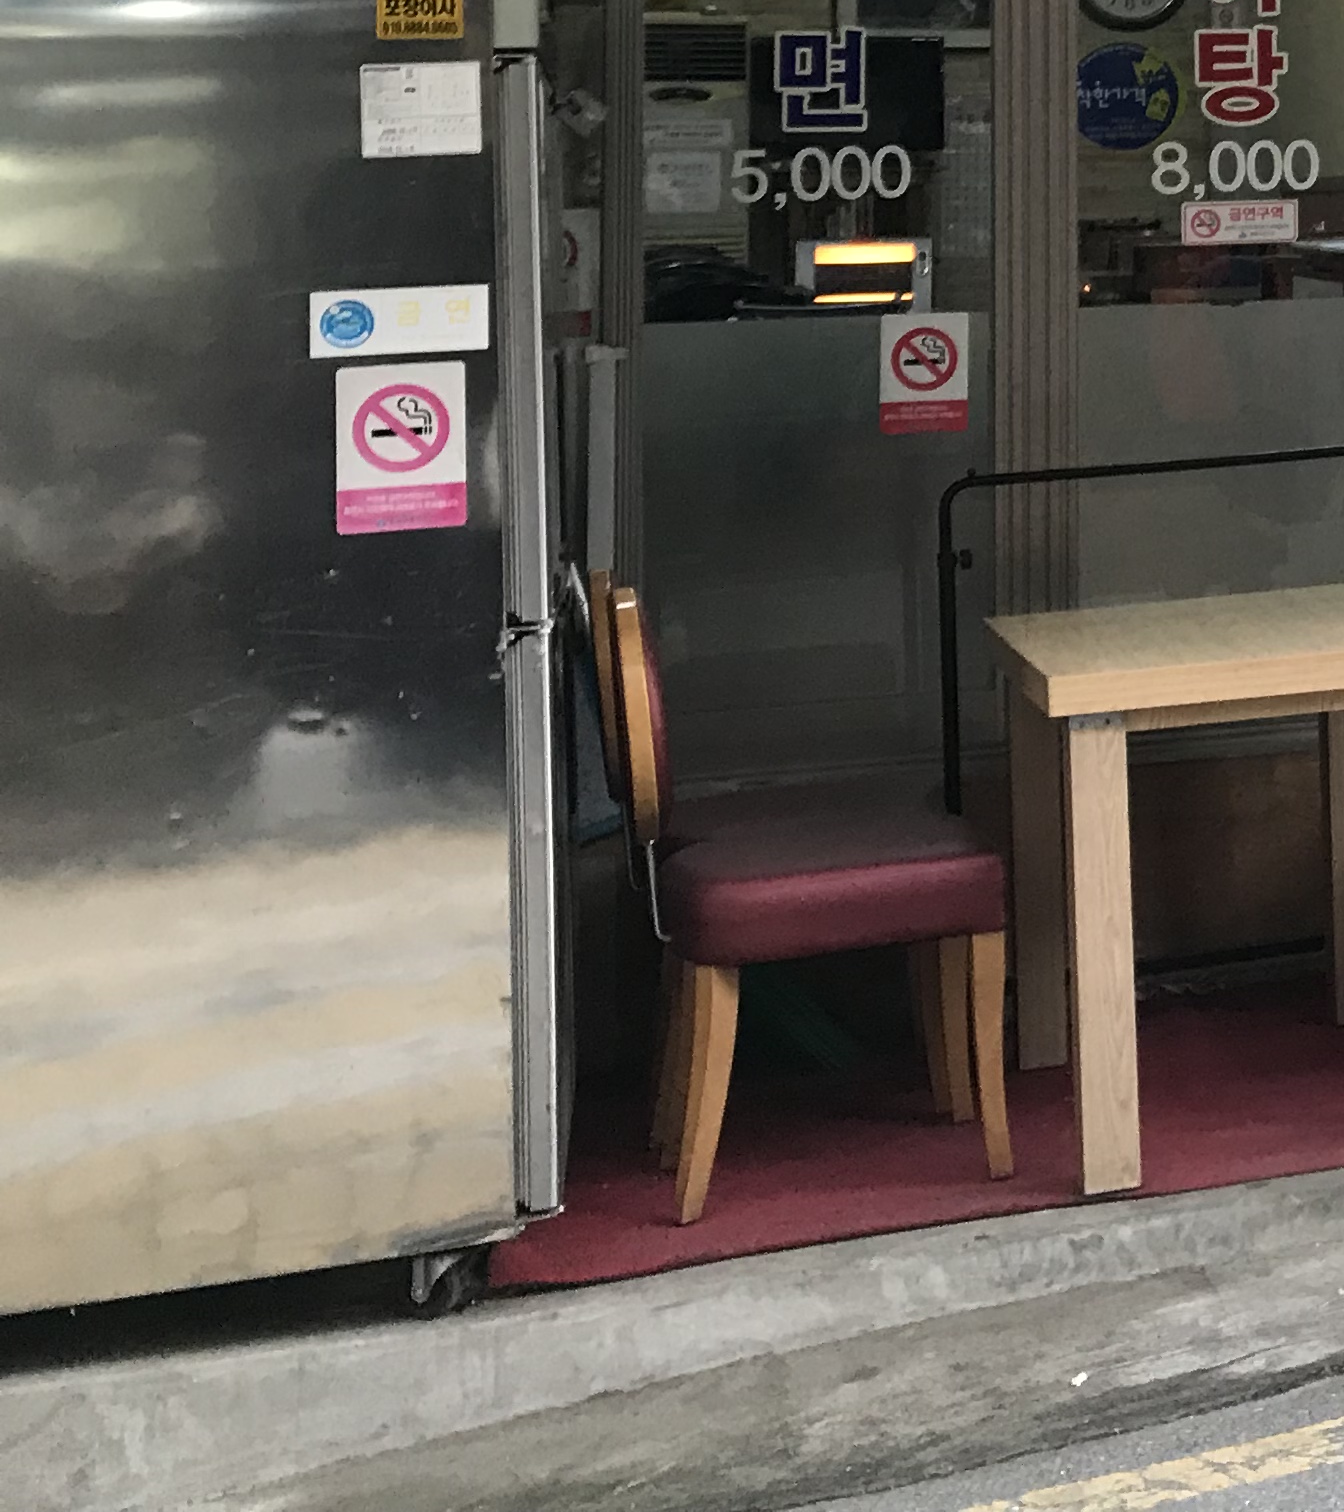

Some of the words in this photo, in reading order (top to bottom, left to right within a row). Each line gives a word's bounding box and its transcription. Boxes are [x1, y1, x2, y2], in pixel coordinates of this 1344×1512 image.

[730, 145, 912, 210] 5,000
[1151, 139, 1320, 200] 8,000
[1228, 206, 1284, 222] 금연구역
